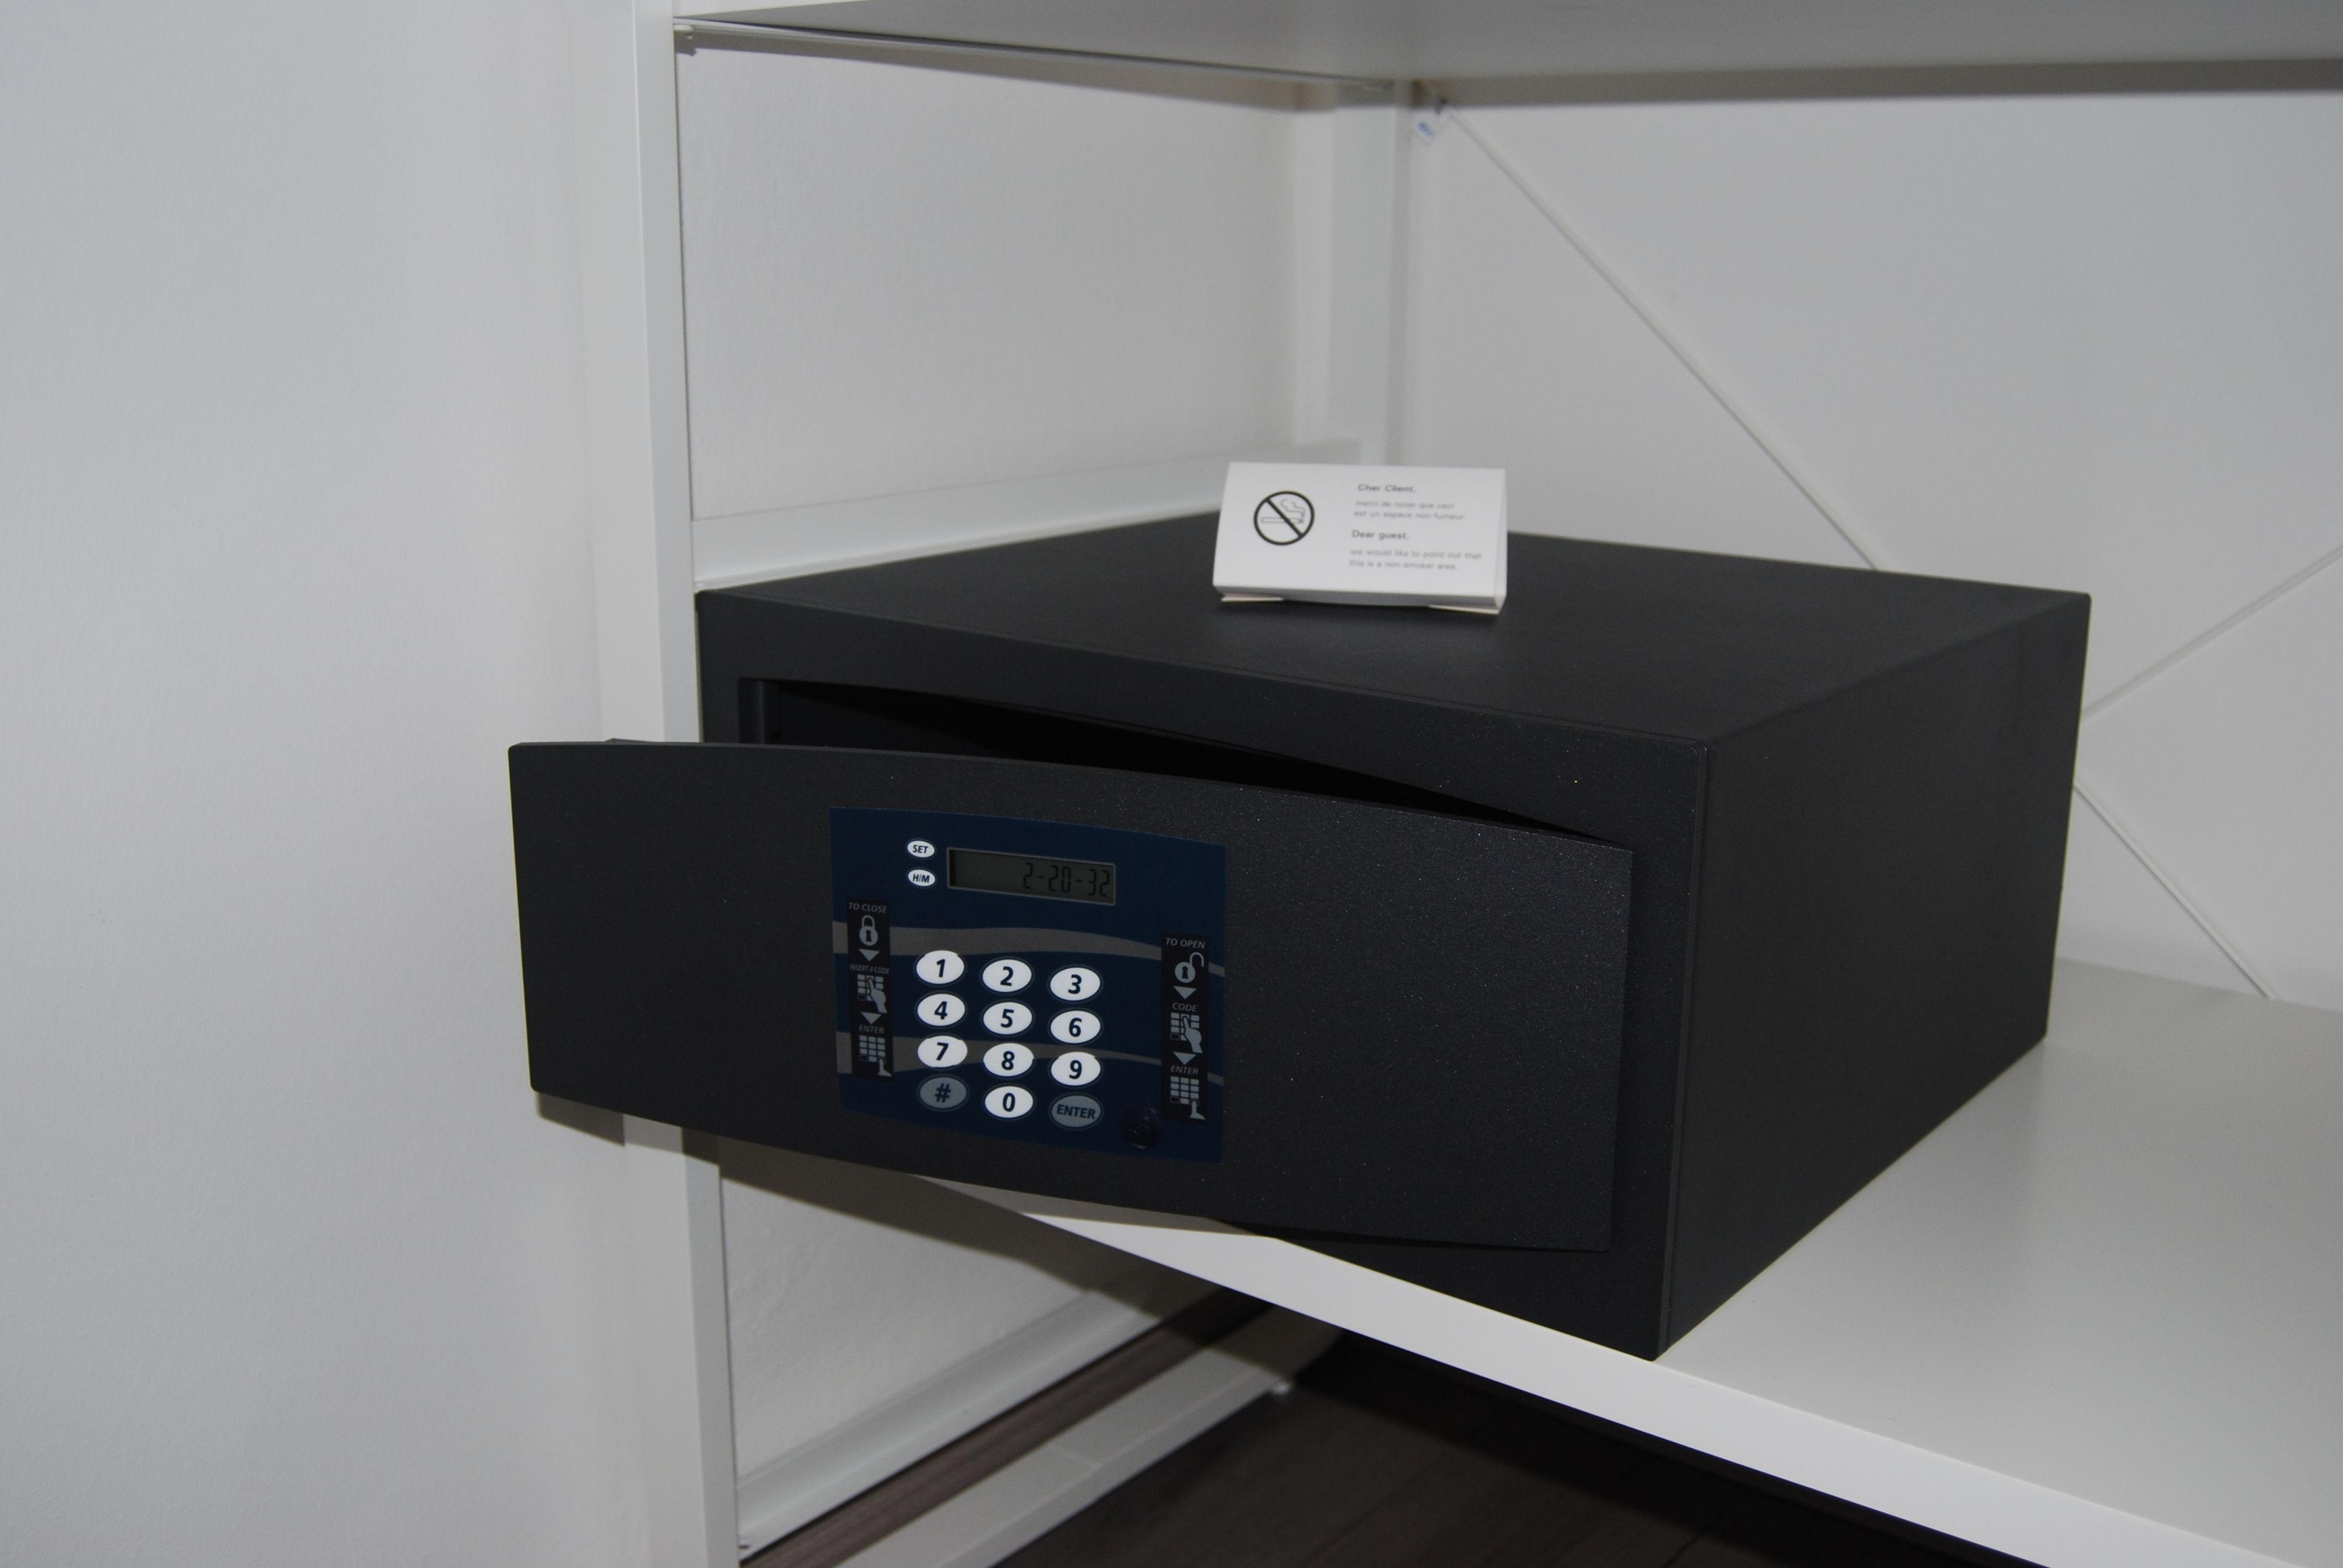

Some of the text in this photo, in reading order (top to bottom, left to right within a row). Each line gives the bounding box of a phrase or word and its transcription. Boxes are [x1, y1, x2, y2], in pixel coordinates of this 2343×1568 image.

[1358, 483, 1416, 493] Cher Client,
[1383, 511, 1413, 520] espace
[1351, 529, 1409, 541] Dear guest,
[1422, 550, 1445, 559] point
[1464, 551, 1482, 559] that
[912, 844, 929, 854] SET
[912, 874, 930, 883] H/M
[1023, 862, 1109, 897] 2-20-32
[849, 902, 888, 914] TO CLOSE
[1166, 937, 1206, 949] TO OPEN
[849, 963, 869, 973] INSERT
[874, 966, 890, 975] CODE
[936, 958, 1082, 994] 1 2 3
[1172, 1002, 1198, 1012] CODE
[934, 1001, 1082, 1038] 4 5 6
[859, 1024, 885, 1034] ENTER
[936, 1041, 1082, 1080] 7 8 9
[1170, 1065, 1199, 1076] ENTER
[1002, 1092, 1016, 1112] 0
[1056, 1104, 1096, 1120] ENTER
